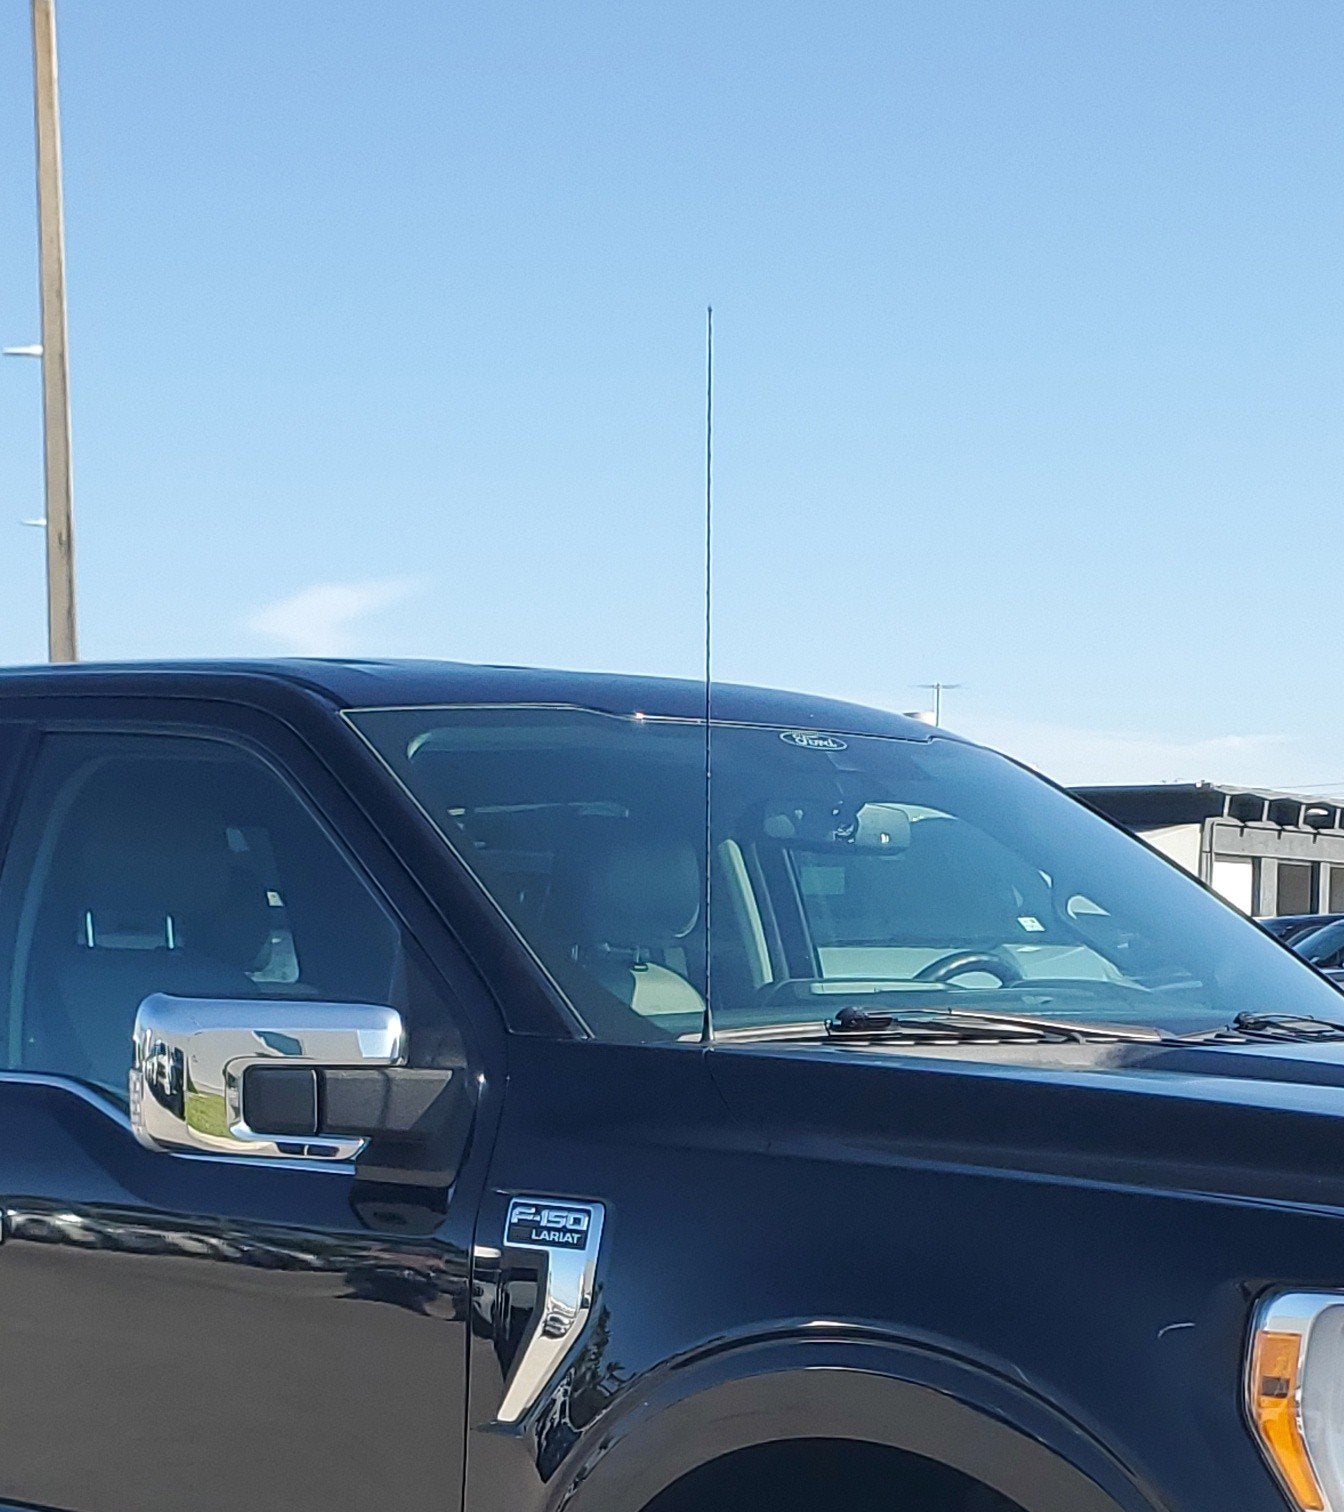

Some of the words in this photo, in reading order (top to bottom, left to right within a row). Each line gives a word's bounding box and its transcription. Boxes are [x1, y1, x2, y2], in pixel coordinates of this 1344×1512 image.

[792, 732, 838, 748] Ford
[511, 1206, 590, 1231] F-150
[531, 1229, 581, 1244] LARIAT
